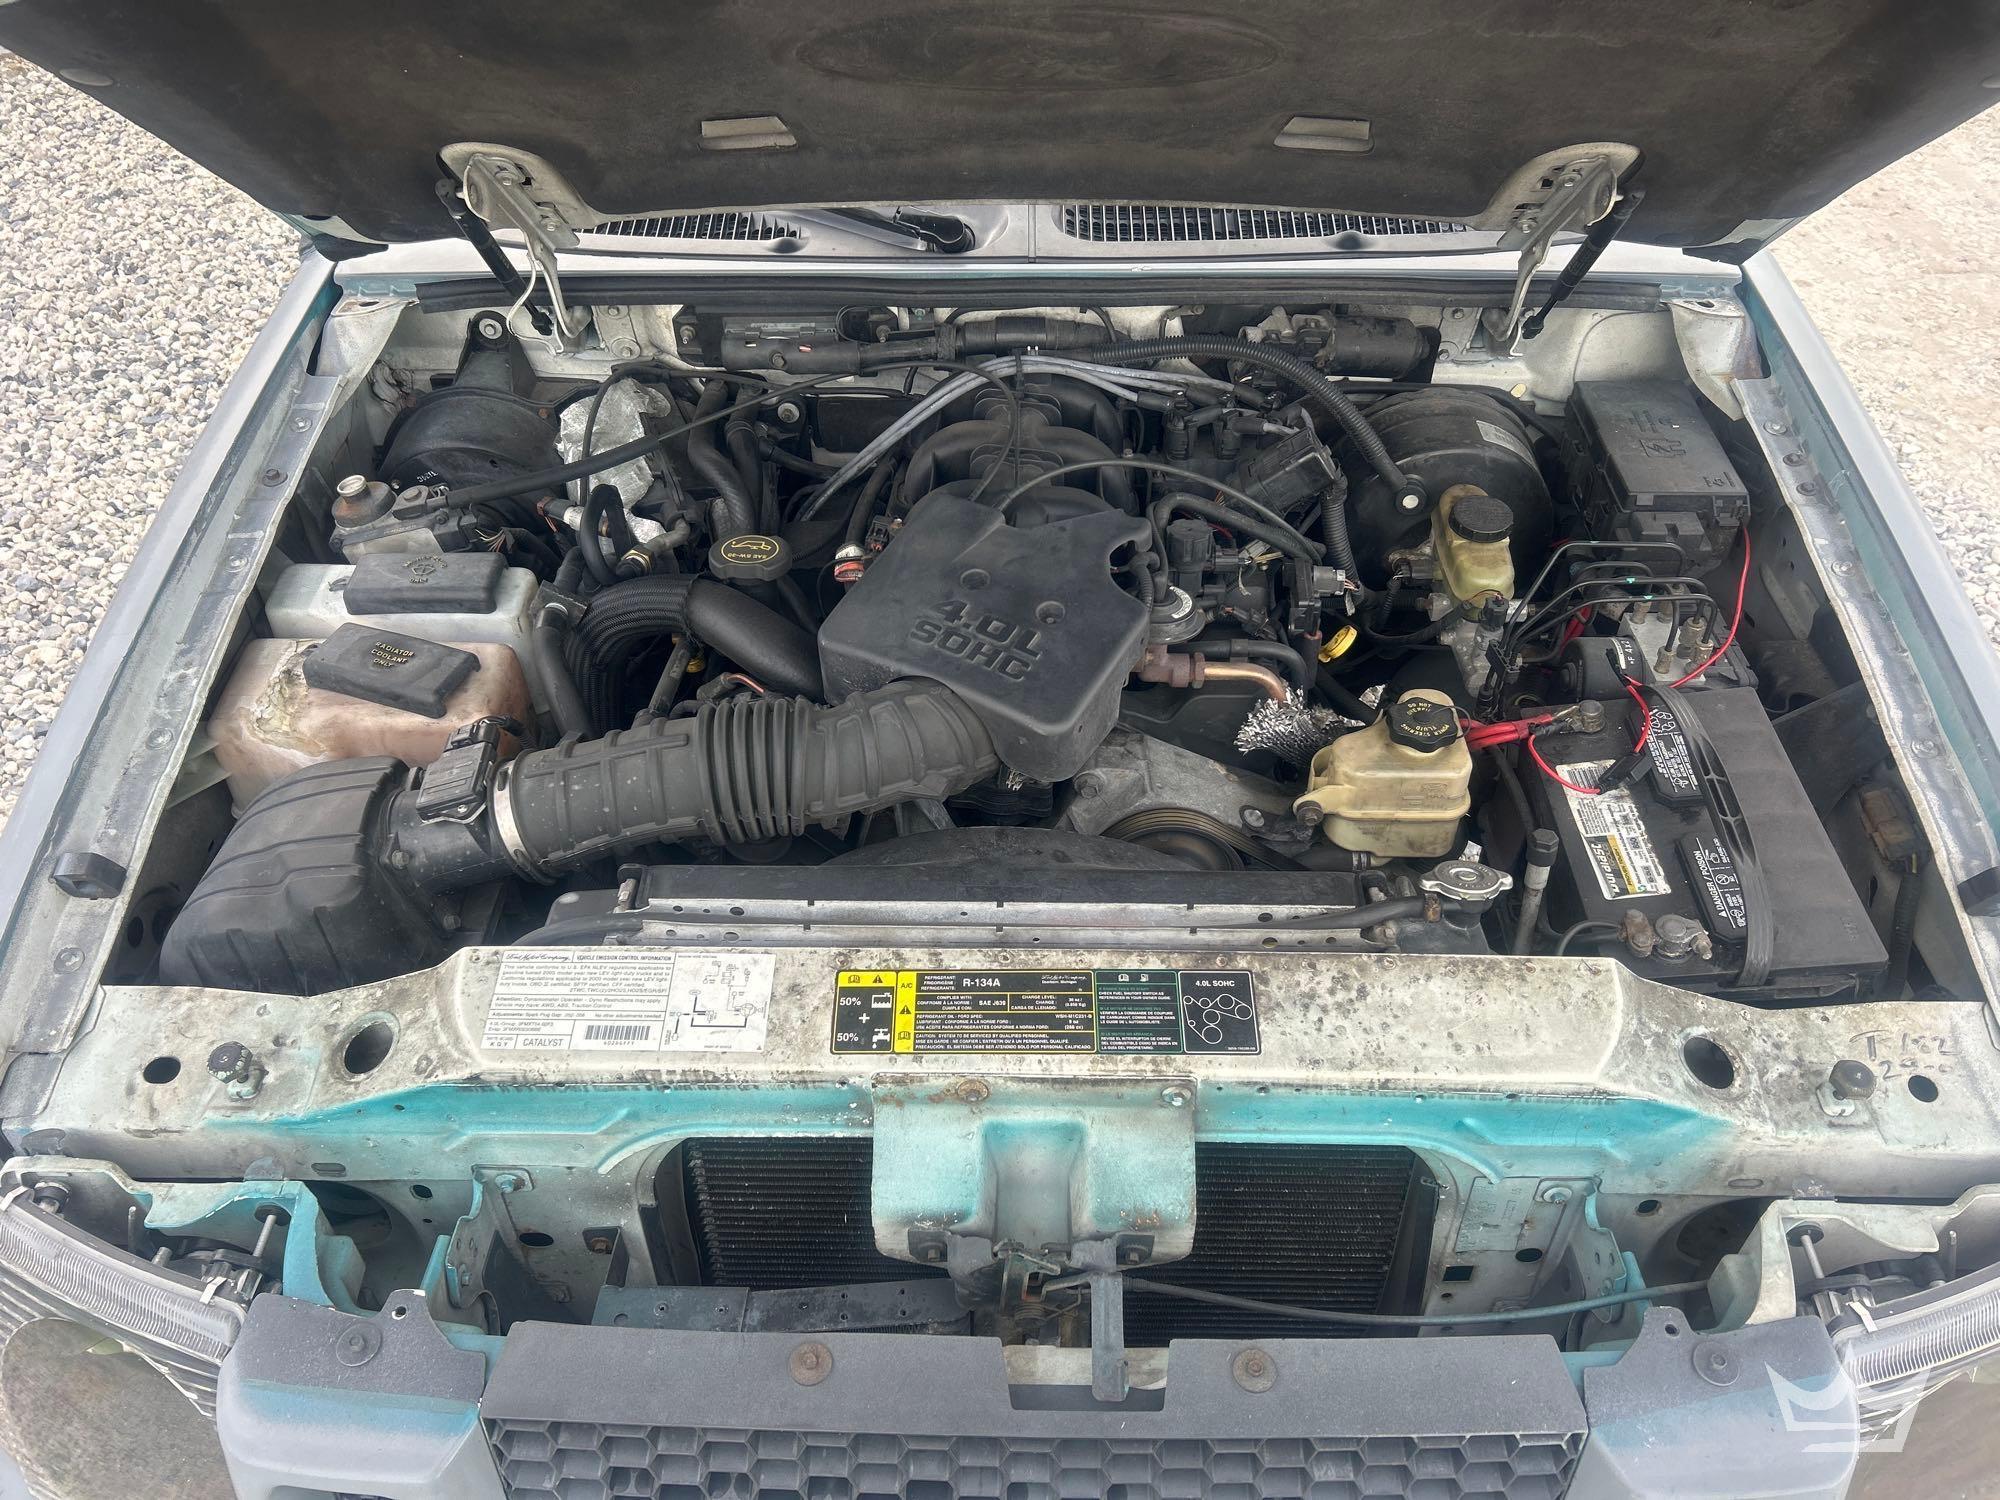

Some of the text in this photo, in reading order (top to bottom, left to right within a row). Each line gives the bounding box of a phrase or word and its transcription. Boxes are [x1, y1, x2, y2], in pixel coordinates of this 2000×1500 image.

[930, 599, 1042, 661] 4.0L
[371, 648, 408, 663] COOLANT
[375, 641, 416, 658] RADIATOR
[910, 619, 1033, 682] SOHC
[373, 658, 393, 668] ONLY
[1693, 850, 1710, 876] POISON
[1708, 881, 1726, 912] DANGER
[962, 978, 1000, 988] R-134A
[840, 997, 861, 1006] 50%
[522, 1038, 564, 1046] CATALYST
[836, 1032, 859, 1042] 50%
